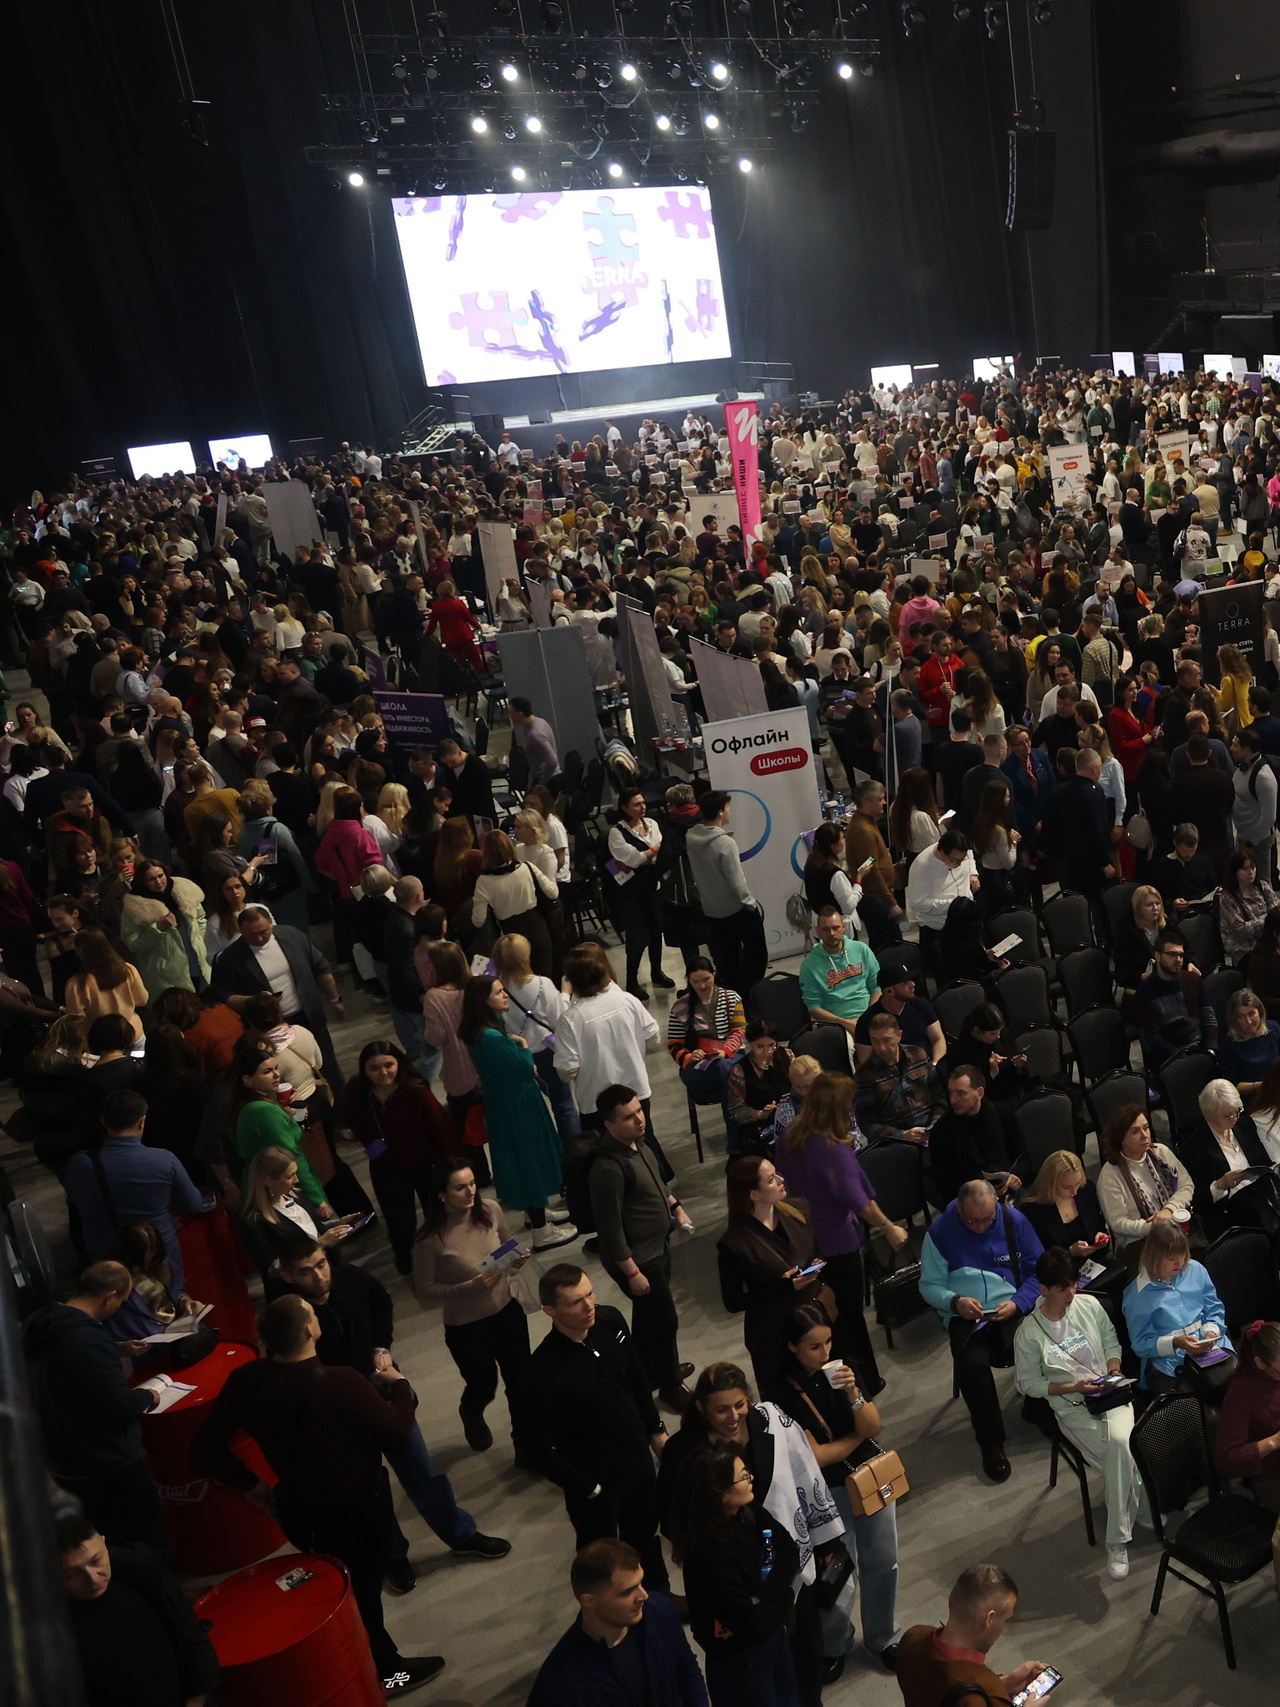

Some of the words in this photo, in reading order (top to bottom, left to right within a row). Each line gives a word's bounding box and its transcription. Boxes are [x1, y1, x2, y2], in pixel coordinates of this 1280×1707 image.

[738, 458, 746, 487] НИШИ
[740, 490, 749, 524] БИЗНЕС
[1217, 617, 1251, 632] TERRA
[1238, 639, 1254, 647] стать
[379, 702, 408, 711] ШКОЛА
[711, 729, 789, 755] Офлайн
[757, 754, 801, 770] Школы
